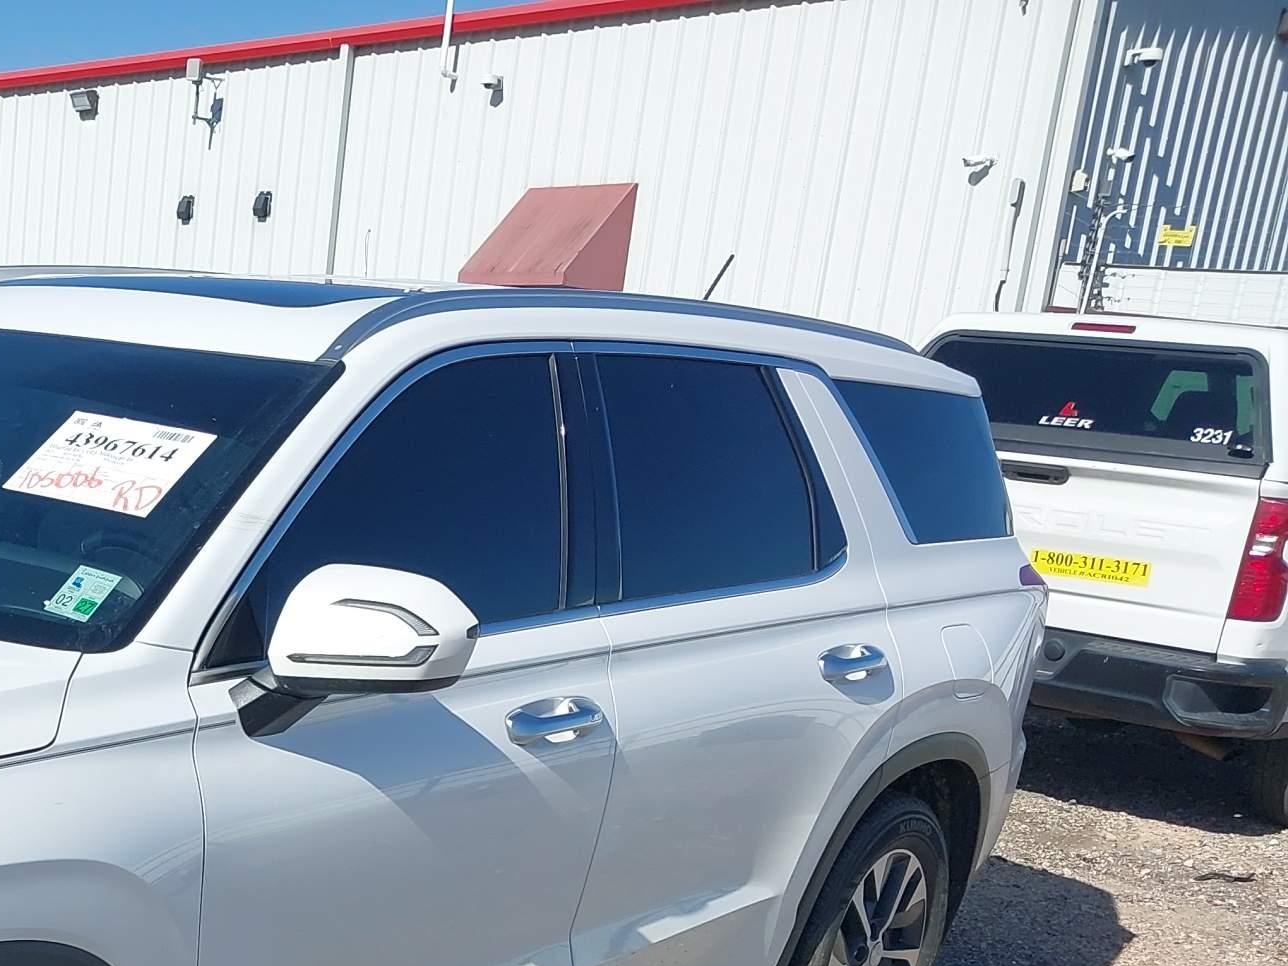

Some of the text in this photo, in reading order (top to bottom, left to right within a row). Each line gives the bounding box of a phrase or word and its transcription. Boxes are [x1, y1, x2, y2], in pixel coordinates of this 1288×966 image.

[1038, 415, 1096, 429] LEER
[1190, 427, 1233, 446] 3231
[65, 432, 180, 462] 43967614
[1032, 550, 1149, 577] 1-800-311-3171
[1049, 566, 1079, 576] VEHICLE
[55, 593, 73, 607] 02
